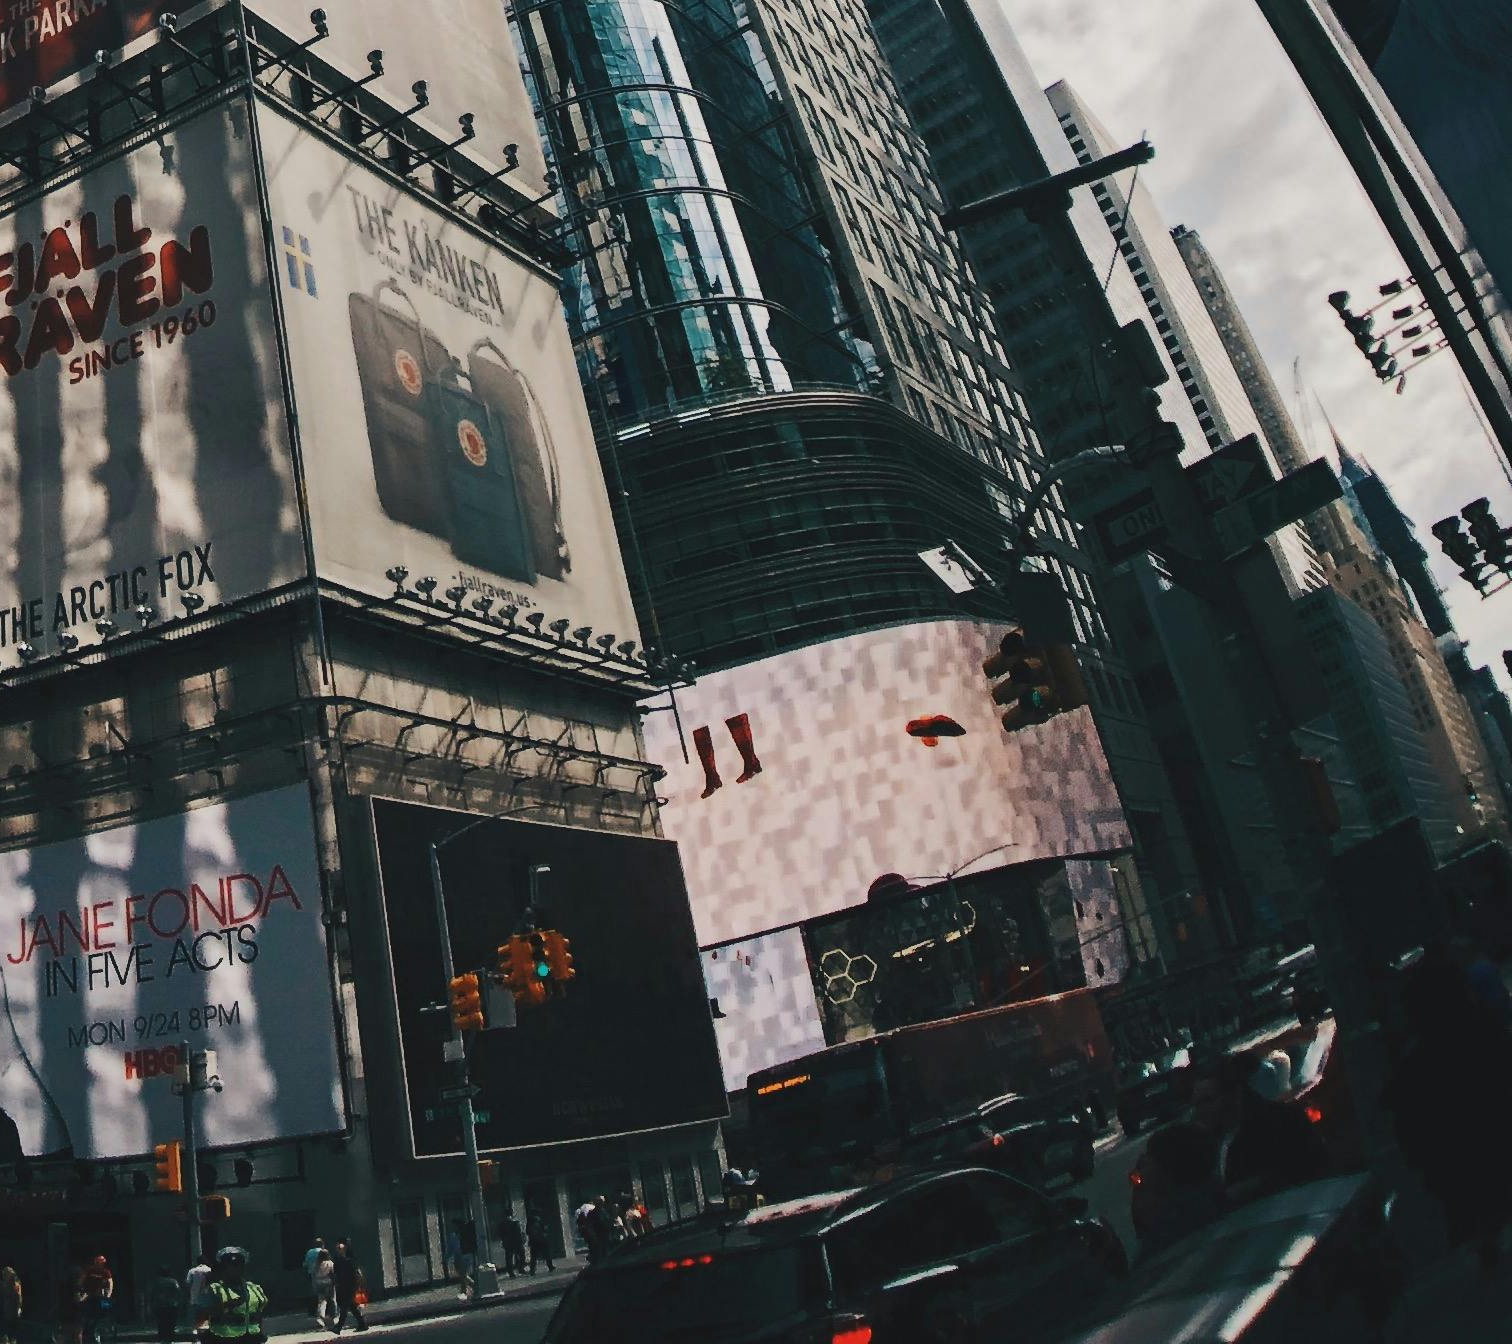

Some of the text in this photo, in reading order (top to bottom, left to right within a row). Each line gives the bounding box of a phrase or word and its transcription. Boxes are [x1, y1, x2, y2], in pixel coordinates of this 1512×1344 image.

[346, 184, 400, 255] THE
[69, 299, 216, 385] SINCE 1960
[53, 566, 149, 633] ARCTIC
[158, 542, 216, 599] FOX
[7, 864, 302, 964] JANE FONDA
[46, 923, 259, 997] IN FIVE ACTS
[68, 1000, 240, 1050] MON 9/24 8PM
